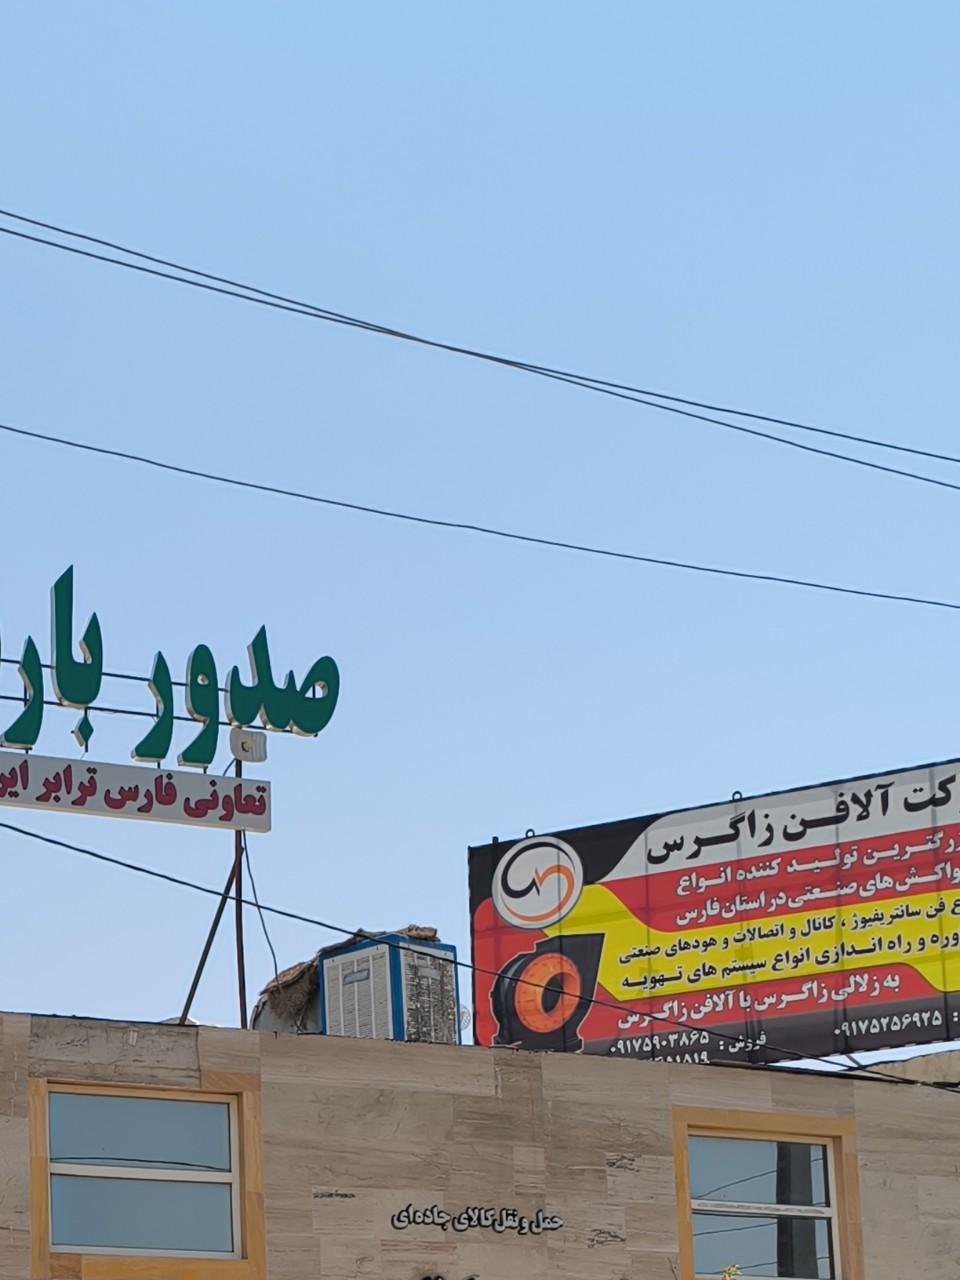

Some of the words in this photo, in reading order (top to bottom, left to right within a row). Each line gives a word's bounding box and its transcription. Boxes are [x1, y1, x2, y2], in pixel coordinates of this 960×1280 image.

[131, 624, 340, 767] صدور
[36, 764, 98, 806] ترابر
[104, 773, 178, 813] فارس
[183, 780, 266, 821] تعاونی
[782, 781, 895, 842] آلافن
[647, 809, 774, 865] زاگرس
[736, 857, 782, 882] کننده
[787, 846, 858, 873] تولید
[676, 866, 732, 896] انواع
[859, 872, 894, 898] های
[721, 890, 766, 918] استان
[767, 892, 786, 912] در
[788, 880, 858, 909] صنعتی
[676, 899, 721, 926] فارس
[851, 903, 921, 930] سانتریفیوژ
[926, 896, 946, 919] فن
[733, 923, 784, 943] اتصالات
[789, 927, 797, 940] و
[800, 915, 836, 937] کانال
[619, 946, 661, 965] صنعتی
[722, 936, 729, 950] و
[815, 937, 883, 965] اندازی
[888, 934, 912, 955] راه
[917, 935, 926, 952] و
[722, 959, 767, 979] سیستم
[772, 948, 810, 971] انواع
[622, 965, 683, 990] تهویه
[687, 962, 718, 984] های
[883, 974, 901, 993] به
[754, 980, 828, 1011] زاگرس
[831, 973, 880, 1000] زلالی
[691, 990, 736, 1020] آلافن
[739, 990, 752, 1012] با
[834, 1010, 943, 1037] ۰۹۱۷۵۲۵۶۹۲۵
[610, 1030, 710, 1055] ۰۹۱۷۵۹۰۳۸۶۵
[452, 1206, 494, 1232] کالای
[493, 1208, 519, 1233] نقل
[529, 1209, 564, 1234] حمل
